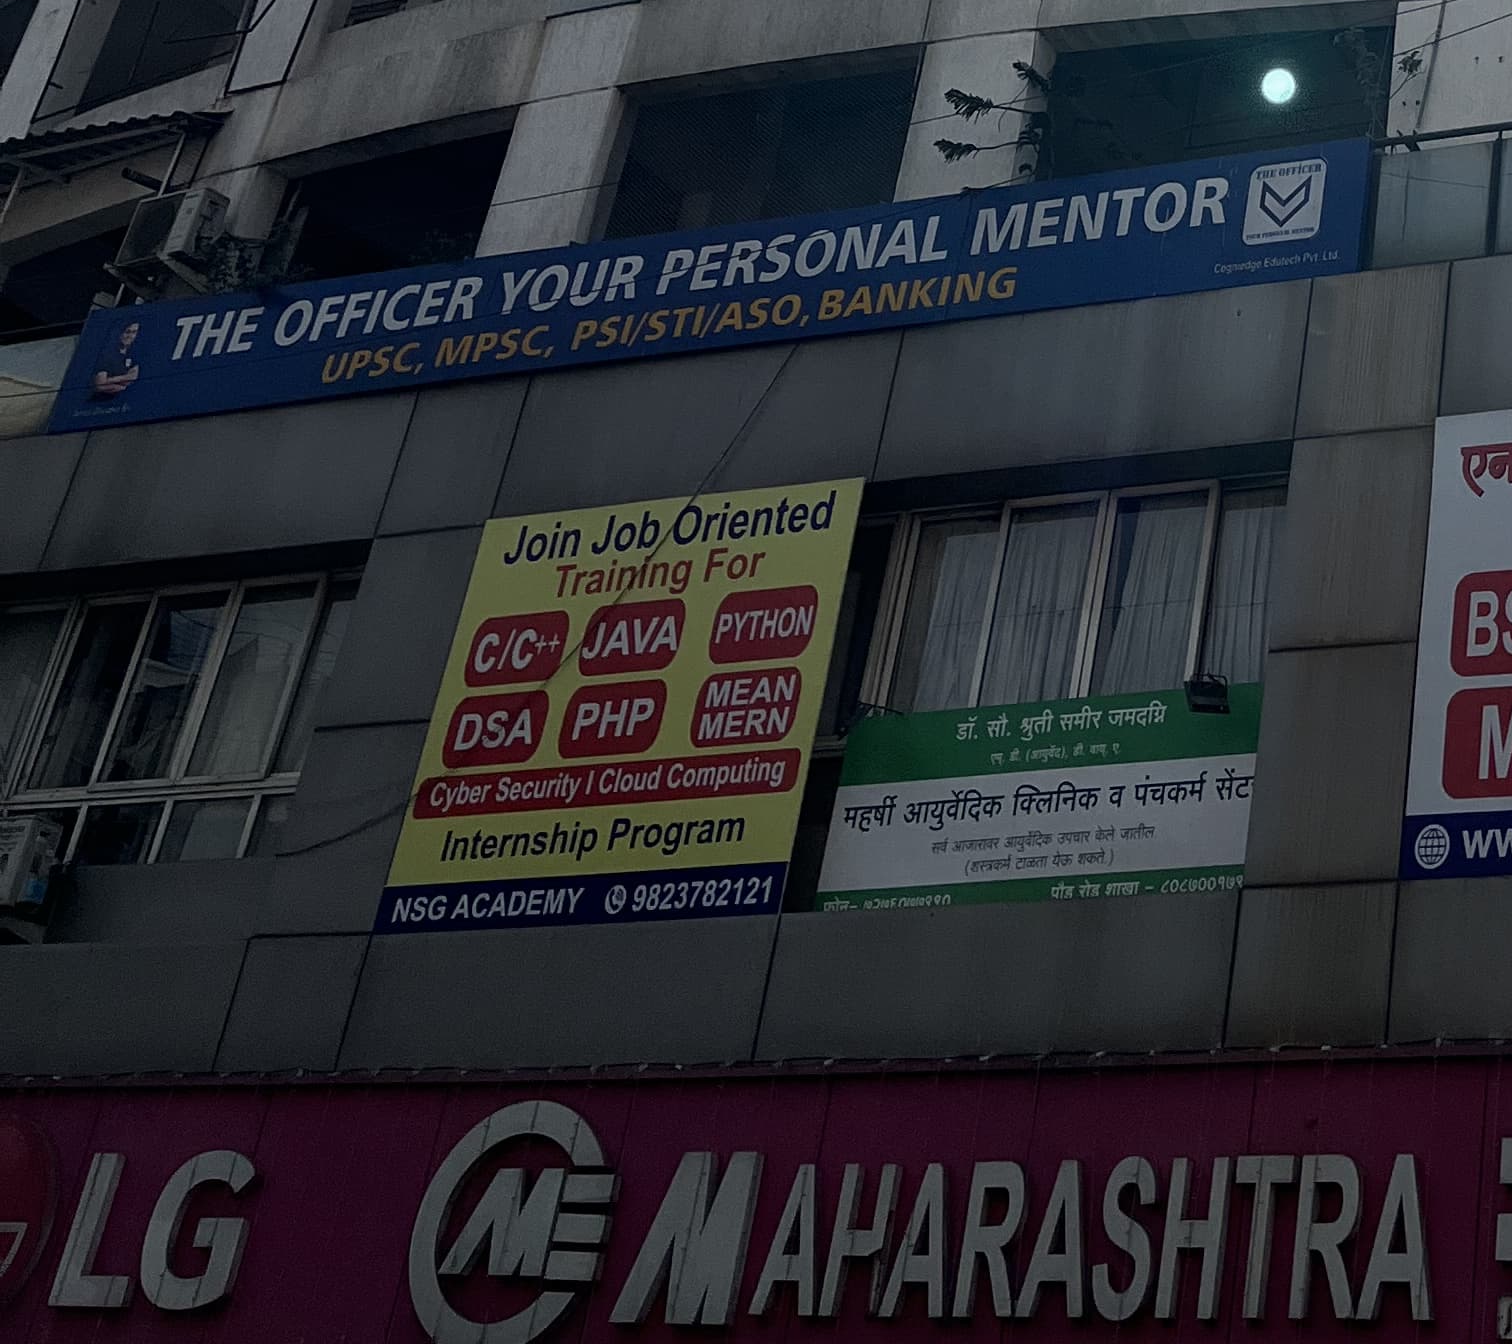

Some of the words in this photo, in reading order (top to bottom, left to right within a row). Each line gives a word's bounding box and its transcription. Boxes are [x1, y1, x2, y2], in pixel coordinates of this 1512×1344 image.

[1255, 168, 1276, 180] THE
[1278, 162, 1322, 178] OFFICER
[169, 314, 265, 361] THE
[273, 275, 484, 348] OFFICER
[500, 254, 647, 314] YOUR
[655, 214, 949, 296] PERSONAL
[968, 177, 1231, 257] MENTOR
[1263, 254, 1301, 268] Edutech
[321, 342, 425, 386] UPSC,
[434, 325, 555, 368] MPSC,
[571, 296, 811, 349] PSI/STI/ASO,
[817, 267, 1019, 320] BANKING
[503, 520, 582, 565] Join
[591, 511, 663, 554] Job
[672, 490, 838, 545] Oriented
[555, 554, 693, 599] Training
[704, 548, 766, 584] For
[581, 615, 679, 661] JAVA
[714, 604, 815, 644] PYTHON
[473, 627, 562, 674] C/C++
[705, 674, 797, 709] MEAN
[453, 707, 533, 752] DSA
[571, 696, 655, 741] PHP
[697, 706, 790, 742] MERN
[955, 715, 979, 742] डॉ.
[986, 713, 1012, 738] सौ.
[1019, 709, 1055, 742] श्रुती
[1059, 705, 1103, 732] समीर
[429, 779, 492, 813] Cyber
[494, 771, 581, 807] Security
[598, 765, 660, 794] Cloud
[669, 756, 786, 792] Computing
[843, 795, 899, 833] महर्षी
[902, 788, 1004, 831] आयुर्वेदिक
[1010, 780, 1100, 817] क्लिनिक
[1108, 786, 1125, 809] व
[1133, 769, 1208, 808] पंचकर्म
[440, 820, 599, 864] Internship
[607, 815, 745, 857] Program
[391, 894, 448, 923] NSG
[451, 887, 585, 921] ACADEMY
[631, 875, 774, 913] 9823782121
[48, 1149, 258, 1310] LG
[608, 1150, 1436, 1326] MAHARASHTRA
